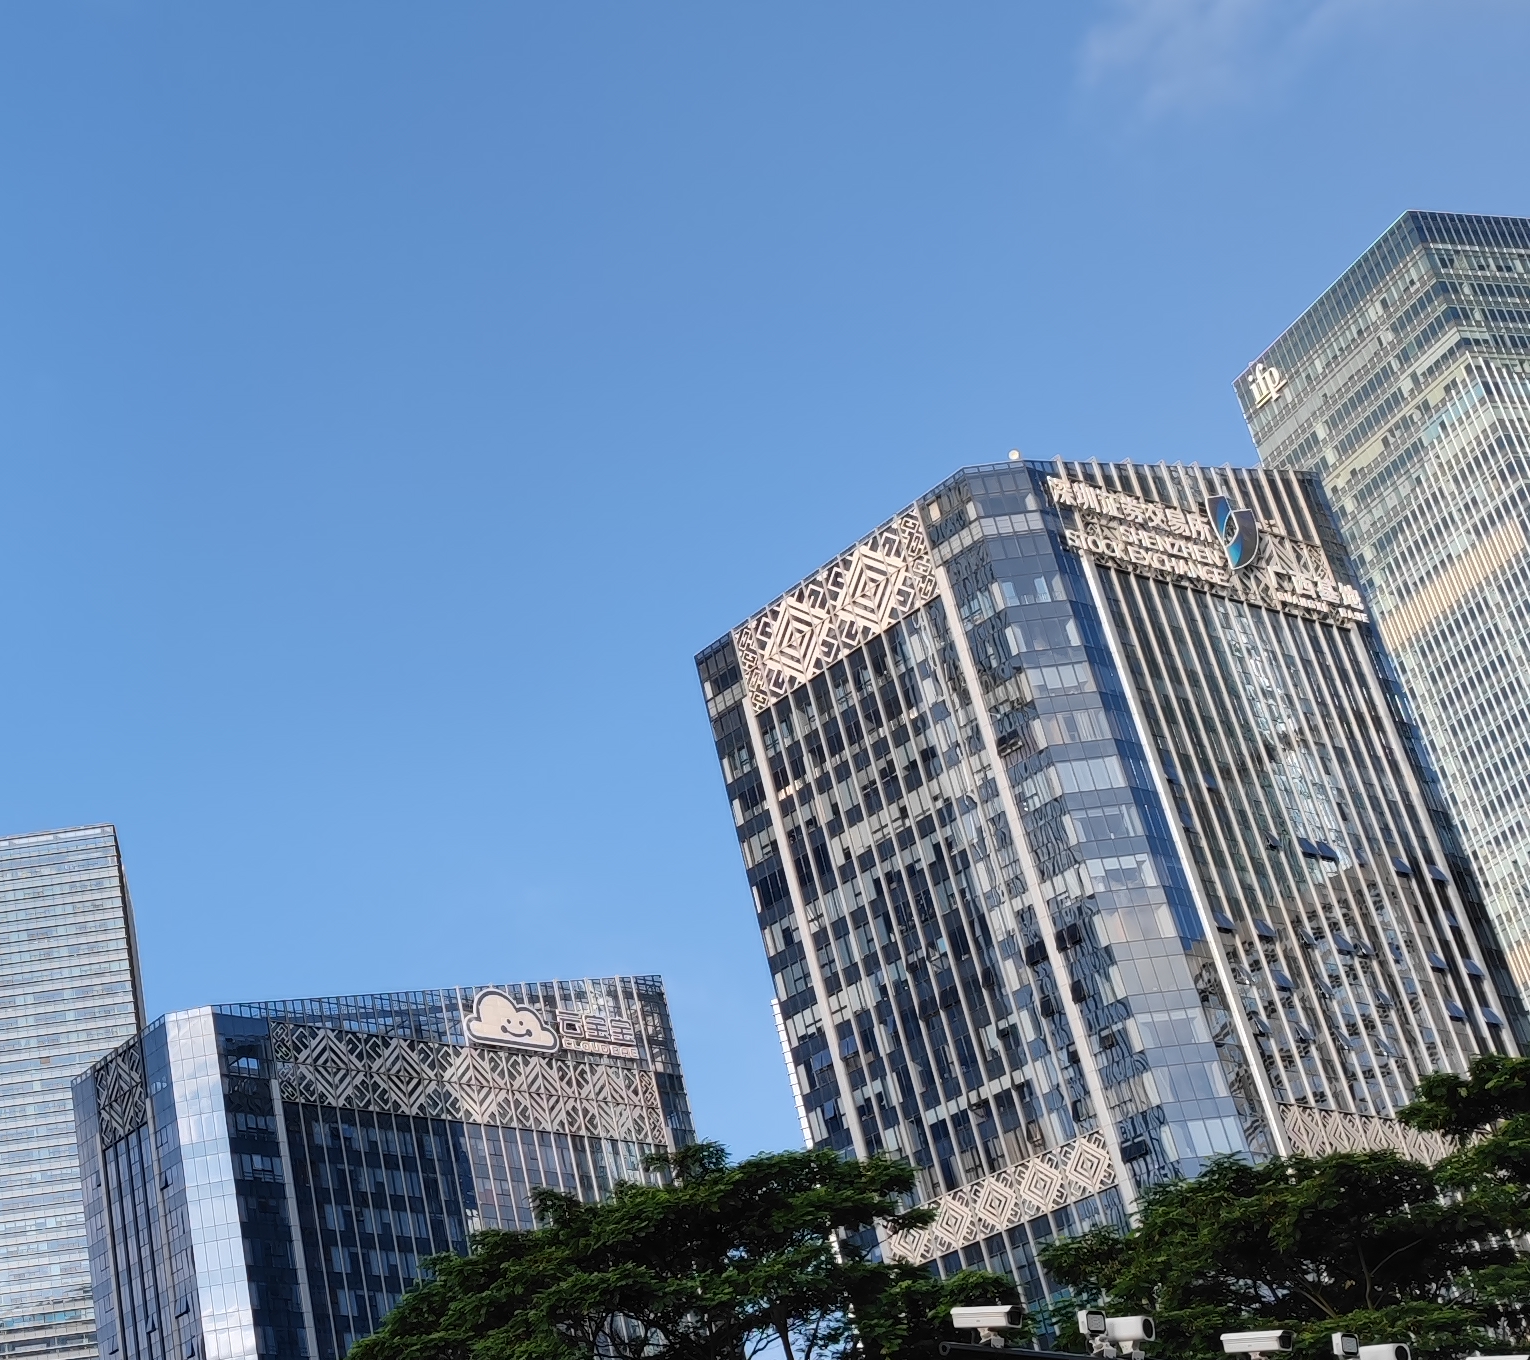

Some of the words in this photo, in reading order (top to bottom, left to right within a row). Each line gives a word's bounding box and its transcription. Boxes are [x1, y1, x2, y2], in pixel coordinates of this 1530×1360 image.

[1048, 476, 1214, 542] 深圳证券交易所
[1065, 529, 1127, 561] STOCK
[1128, 548, 1232, 587] EXCHANGE
[1120, 525, 1226, 567] SHENZHEN
[556, 1009, 638, 1046] 云宝宝
